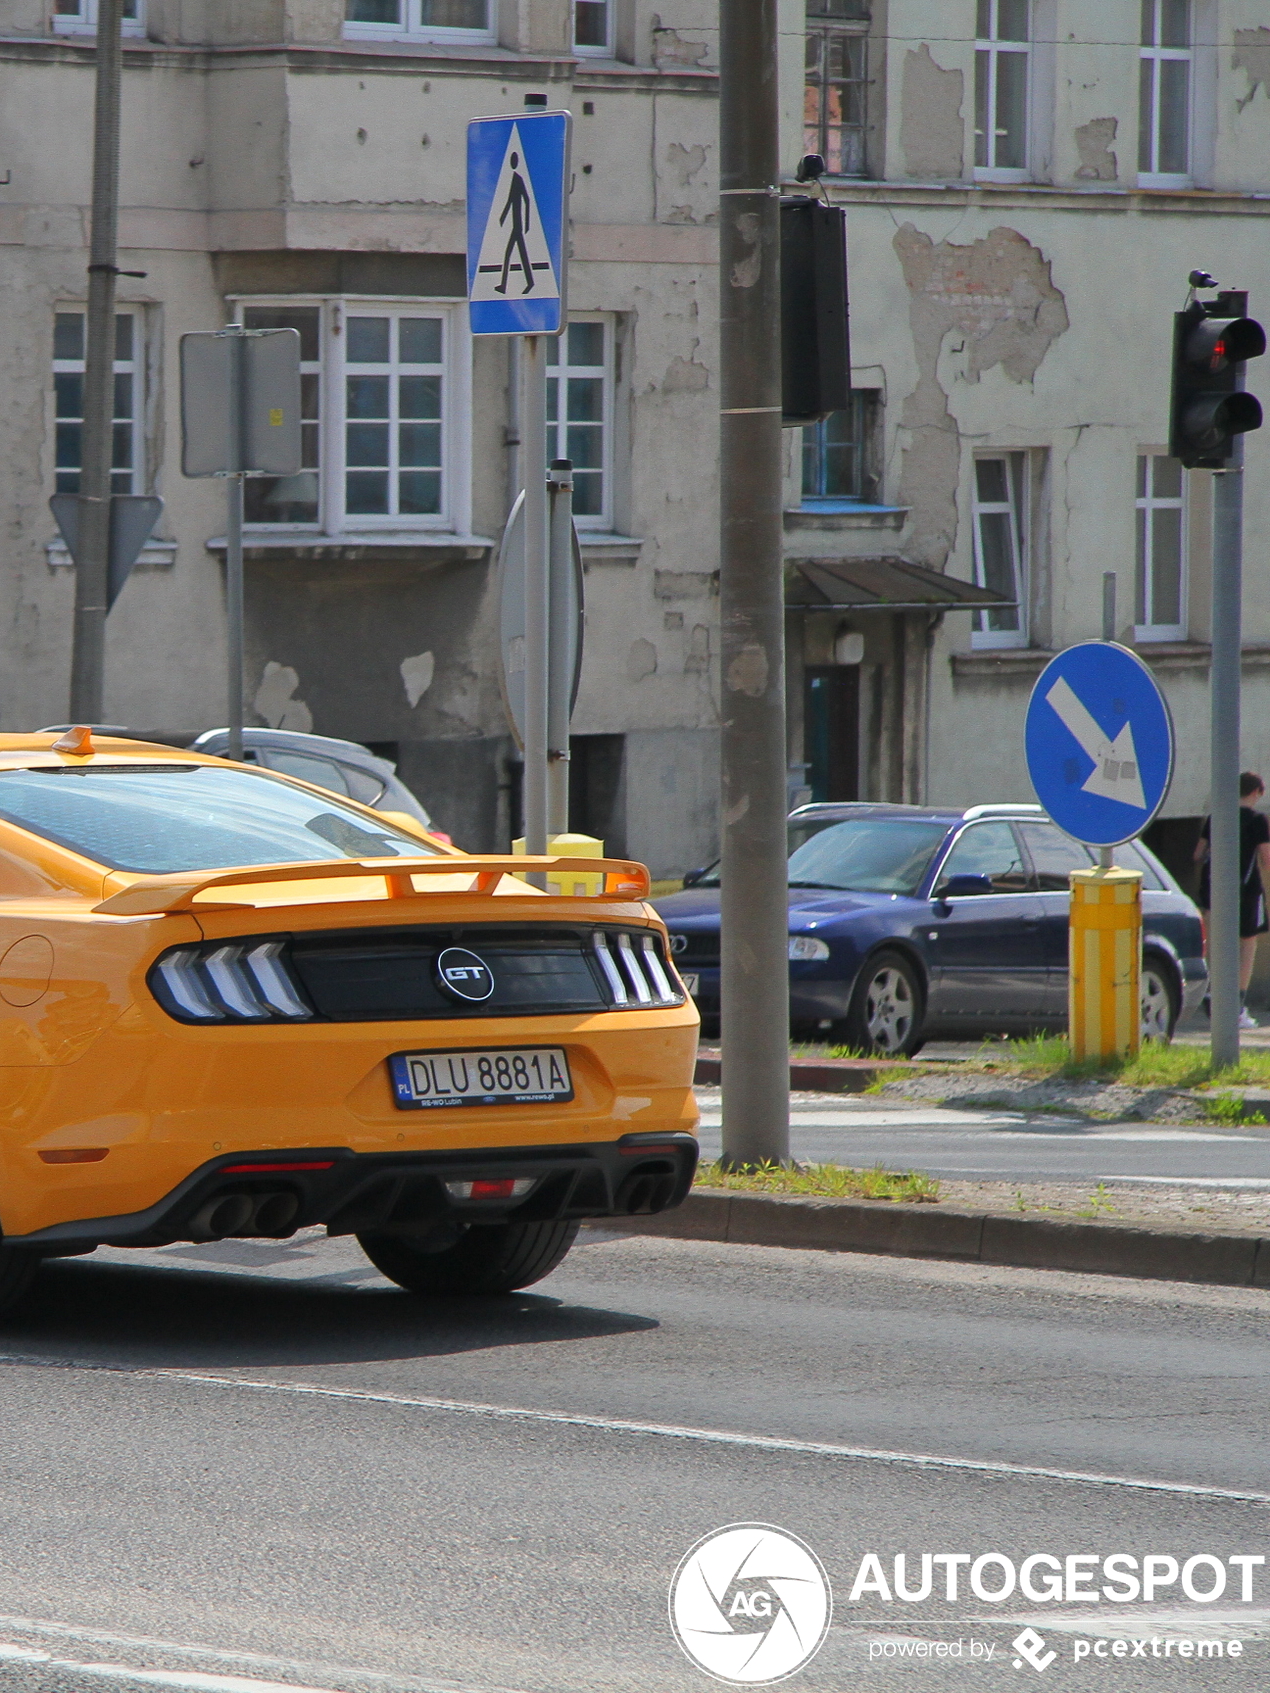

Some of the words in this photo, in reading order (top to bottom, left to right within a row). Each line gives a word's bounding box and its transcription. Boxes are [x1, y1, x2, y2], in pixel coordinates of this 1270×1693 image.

[445, 966, 484, 980] GT
[409, 1057, 470, 1096] DLU
[477, 1054, 566, 1091] 8881A
[398, 1083, 410, 1094] PL
